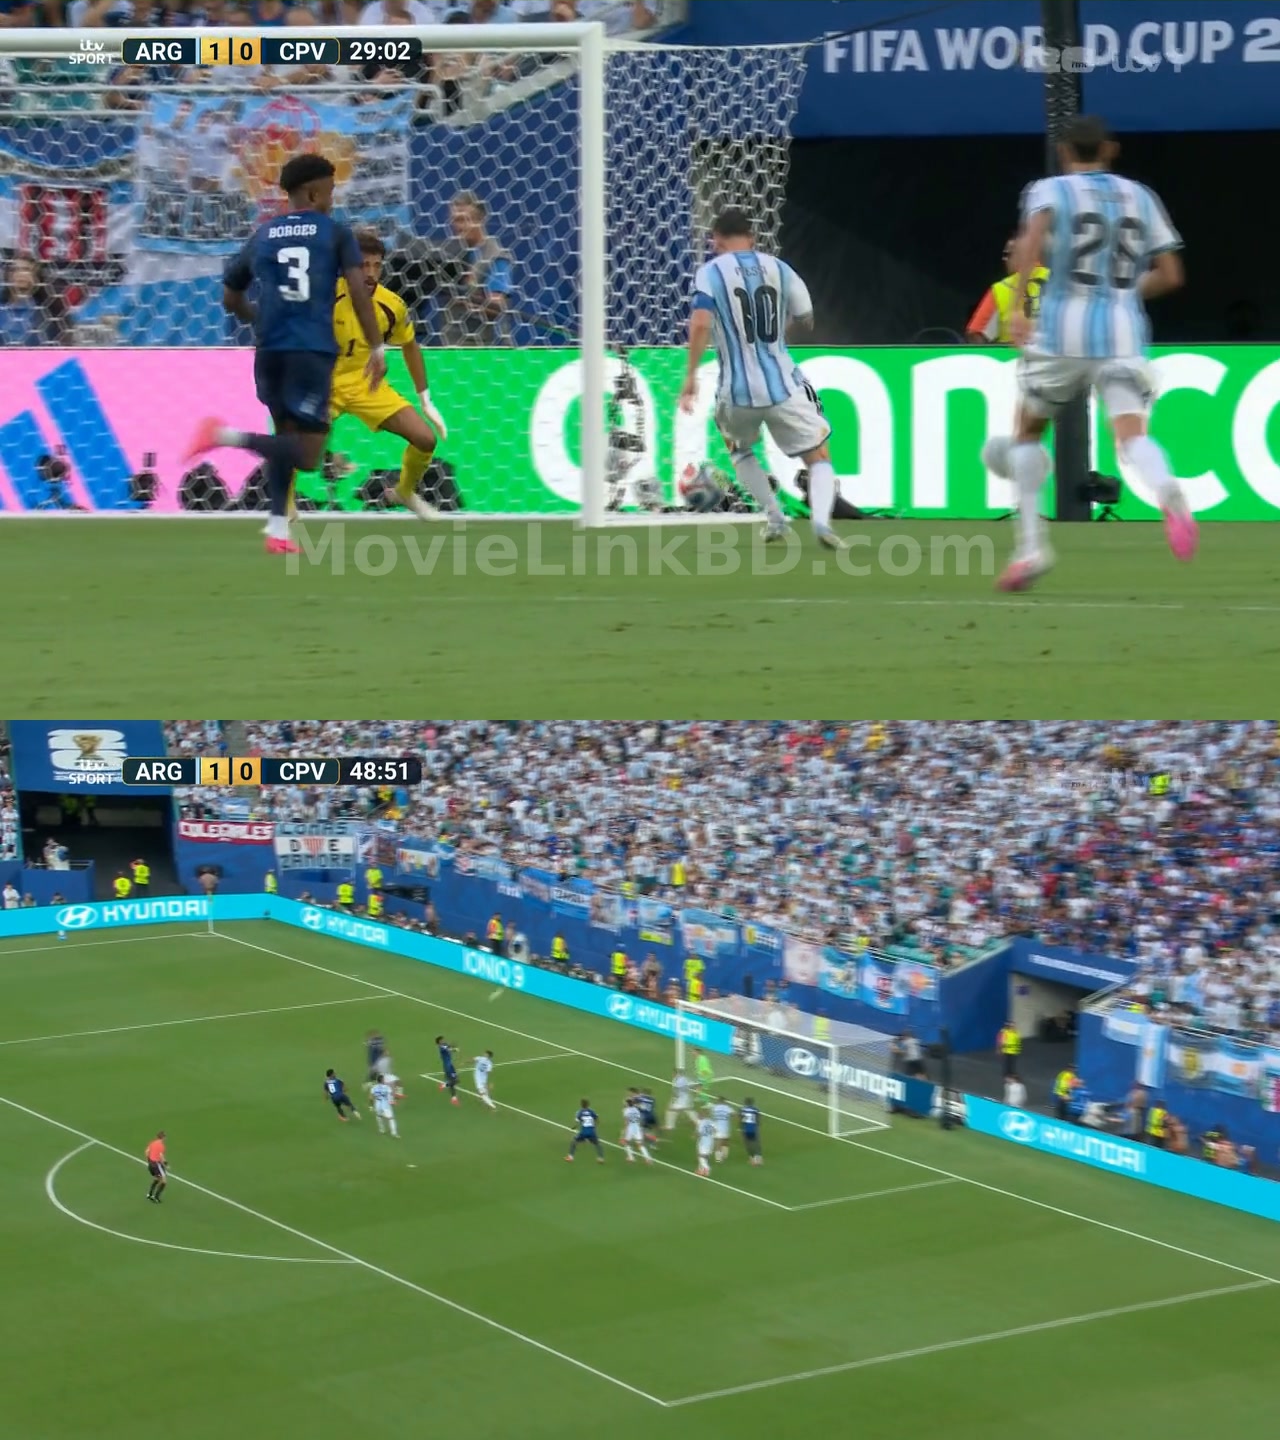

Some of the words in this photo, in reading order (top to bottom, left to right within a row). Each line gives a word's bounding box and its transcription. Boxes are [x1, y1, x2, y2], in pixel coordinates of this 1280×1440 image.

[823, 29, 930, 73] FIFA
[934, 24, 1120, 70] WORD
[1129, 20, 1235, 66] CUP
[268, 224, 317, 239] BORGES
[1071, 212, 1147, 289] 26
[277, 246, 310, 302] 3
[734, 285, 778, 344] 10
[103, 900, 208, 922] HYUNDAI
